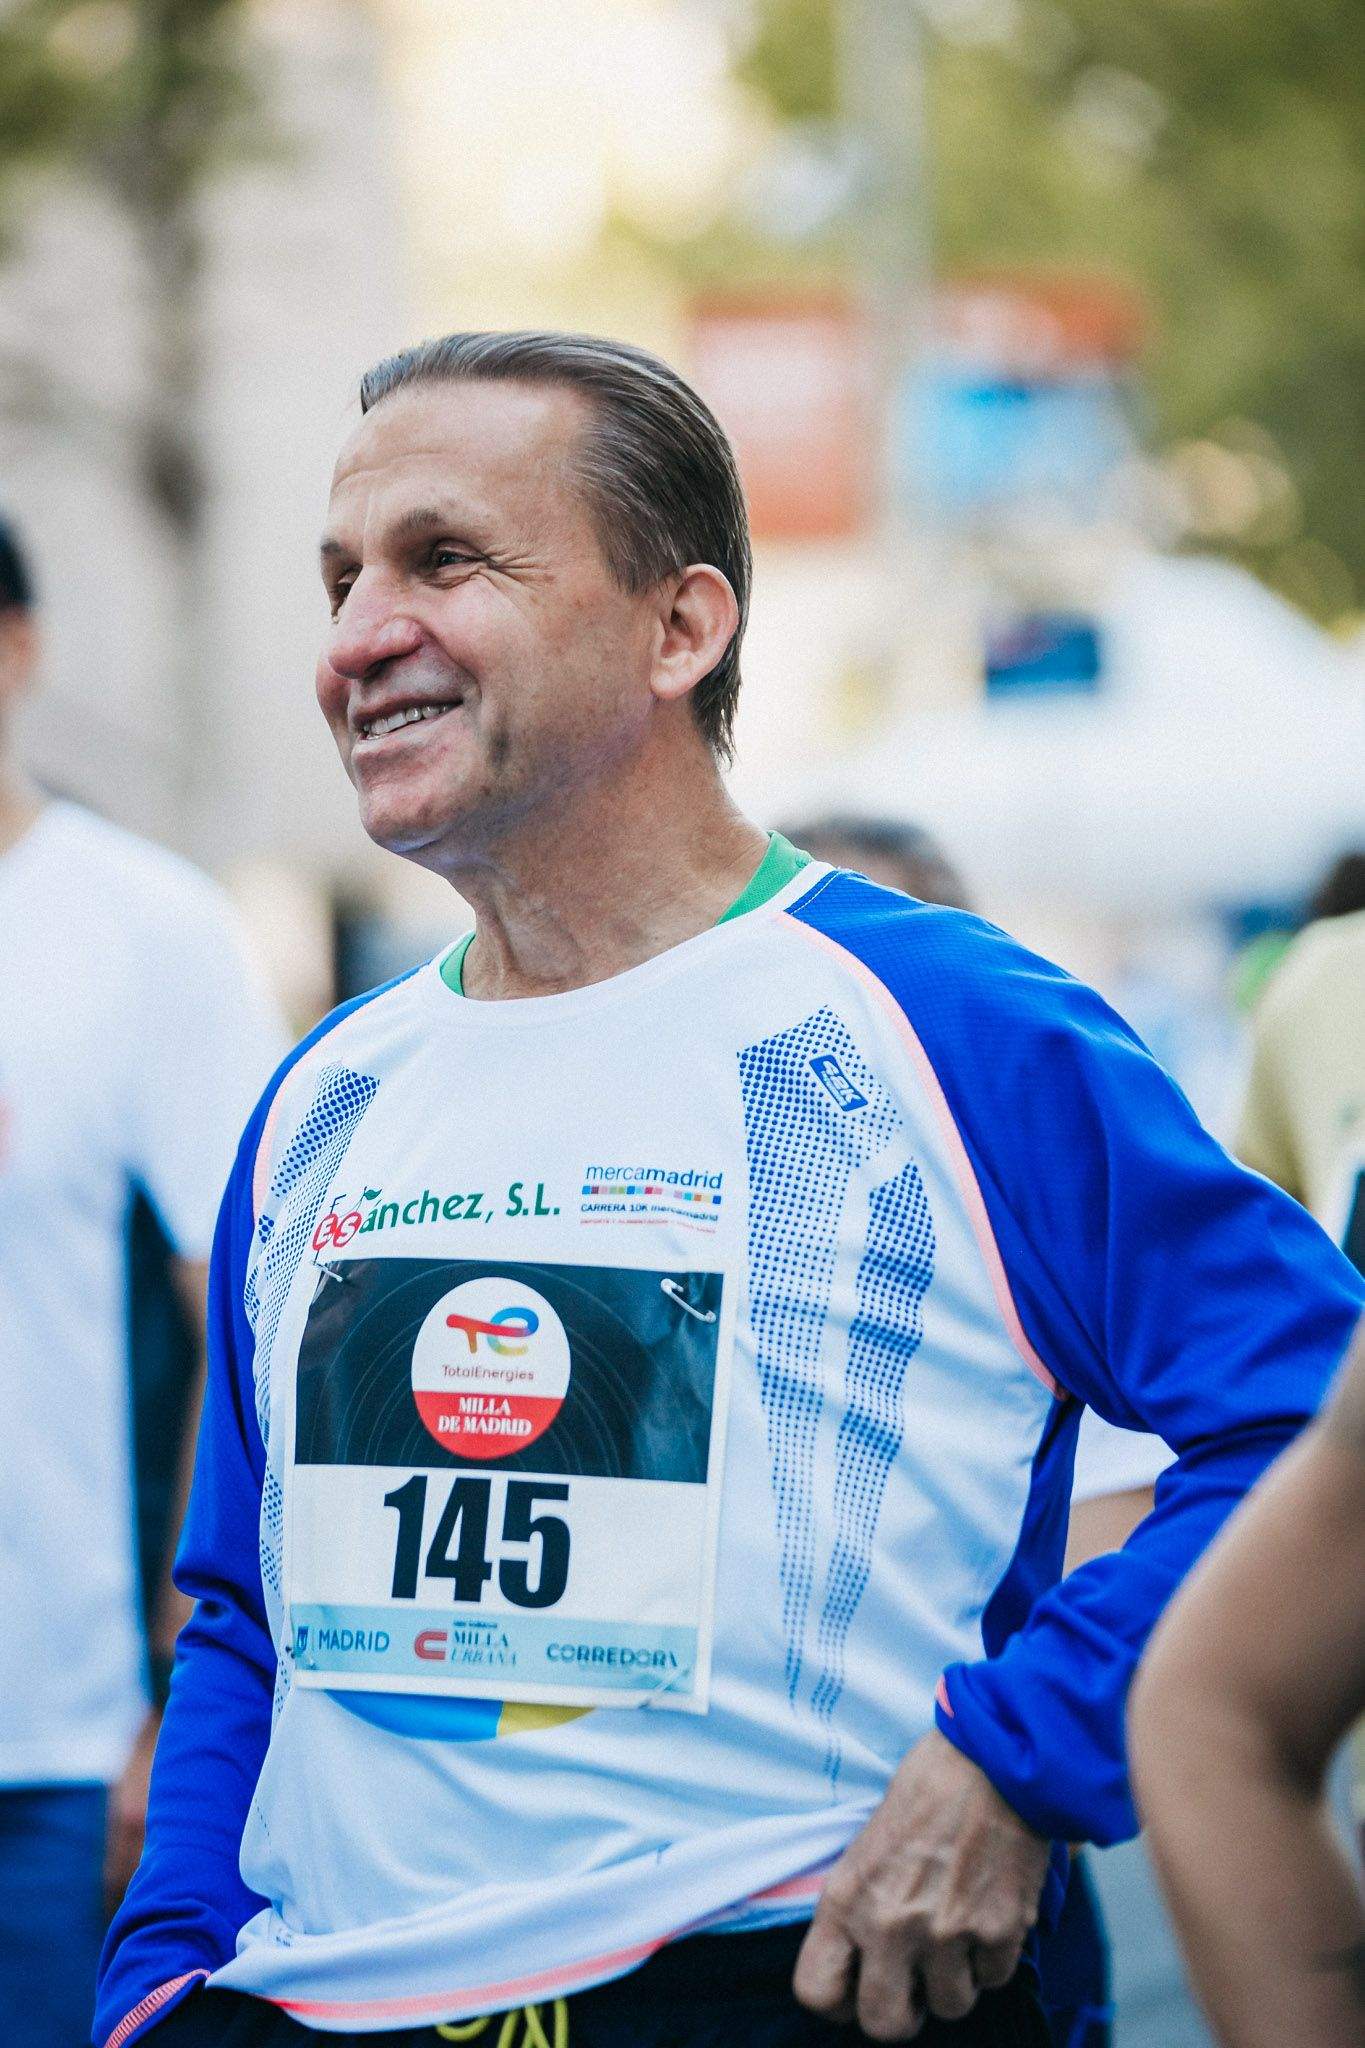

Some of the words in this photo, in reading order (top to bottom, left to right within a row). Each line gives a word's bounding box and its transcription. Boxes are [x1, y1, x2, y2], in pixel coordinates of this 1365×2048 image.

[586, 1166, 723, 1189] mercamadrid
[505, 1182, 561, 1216] S.L.
[580, 1204, 626, 1212] CARRERA
[442, 1364, 535, 1383] TotalEnergies
[458, 1396, 513, 1416] MILLA
[437, 1415, 461, 1433] DE
[463, 1417, 533, 1437] MADRID
[383, 1474, 571, 1609] 145
[317, 1628, 390, 1652] MADRID
